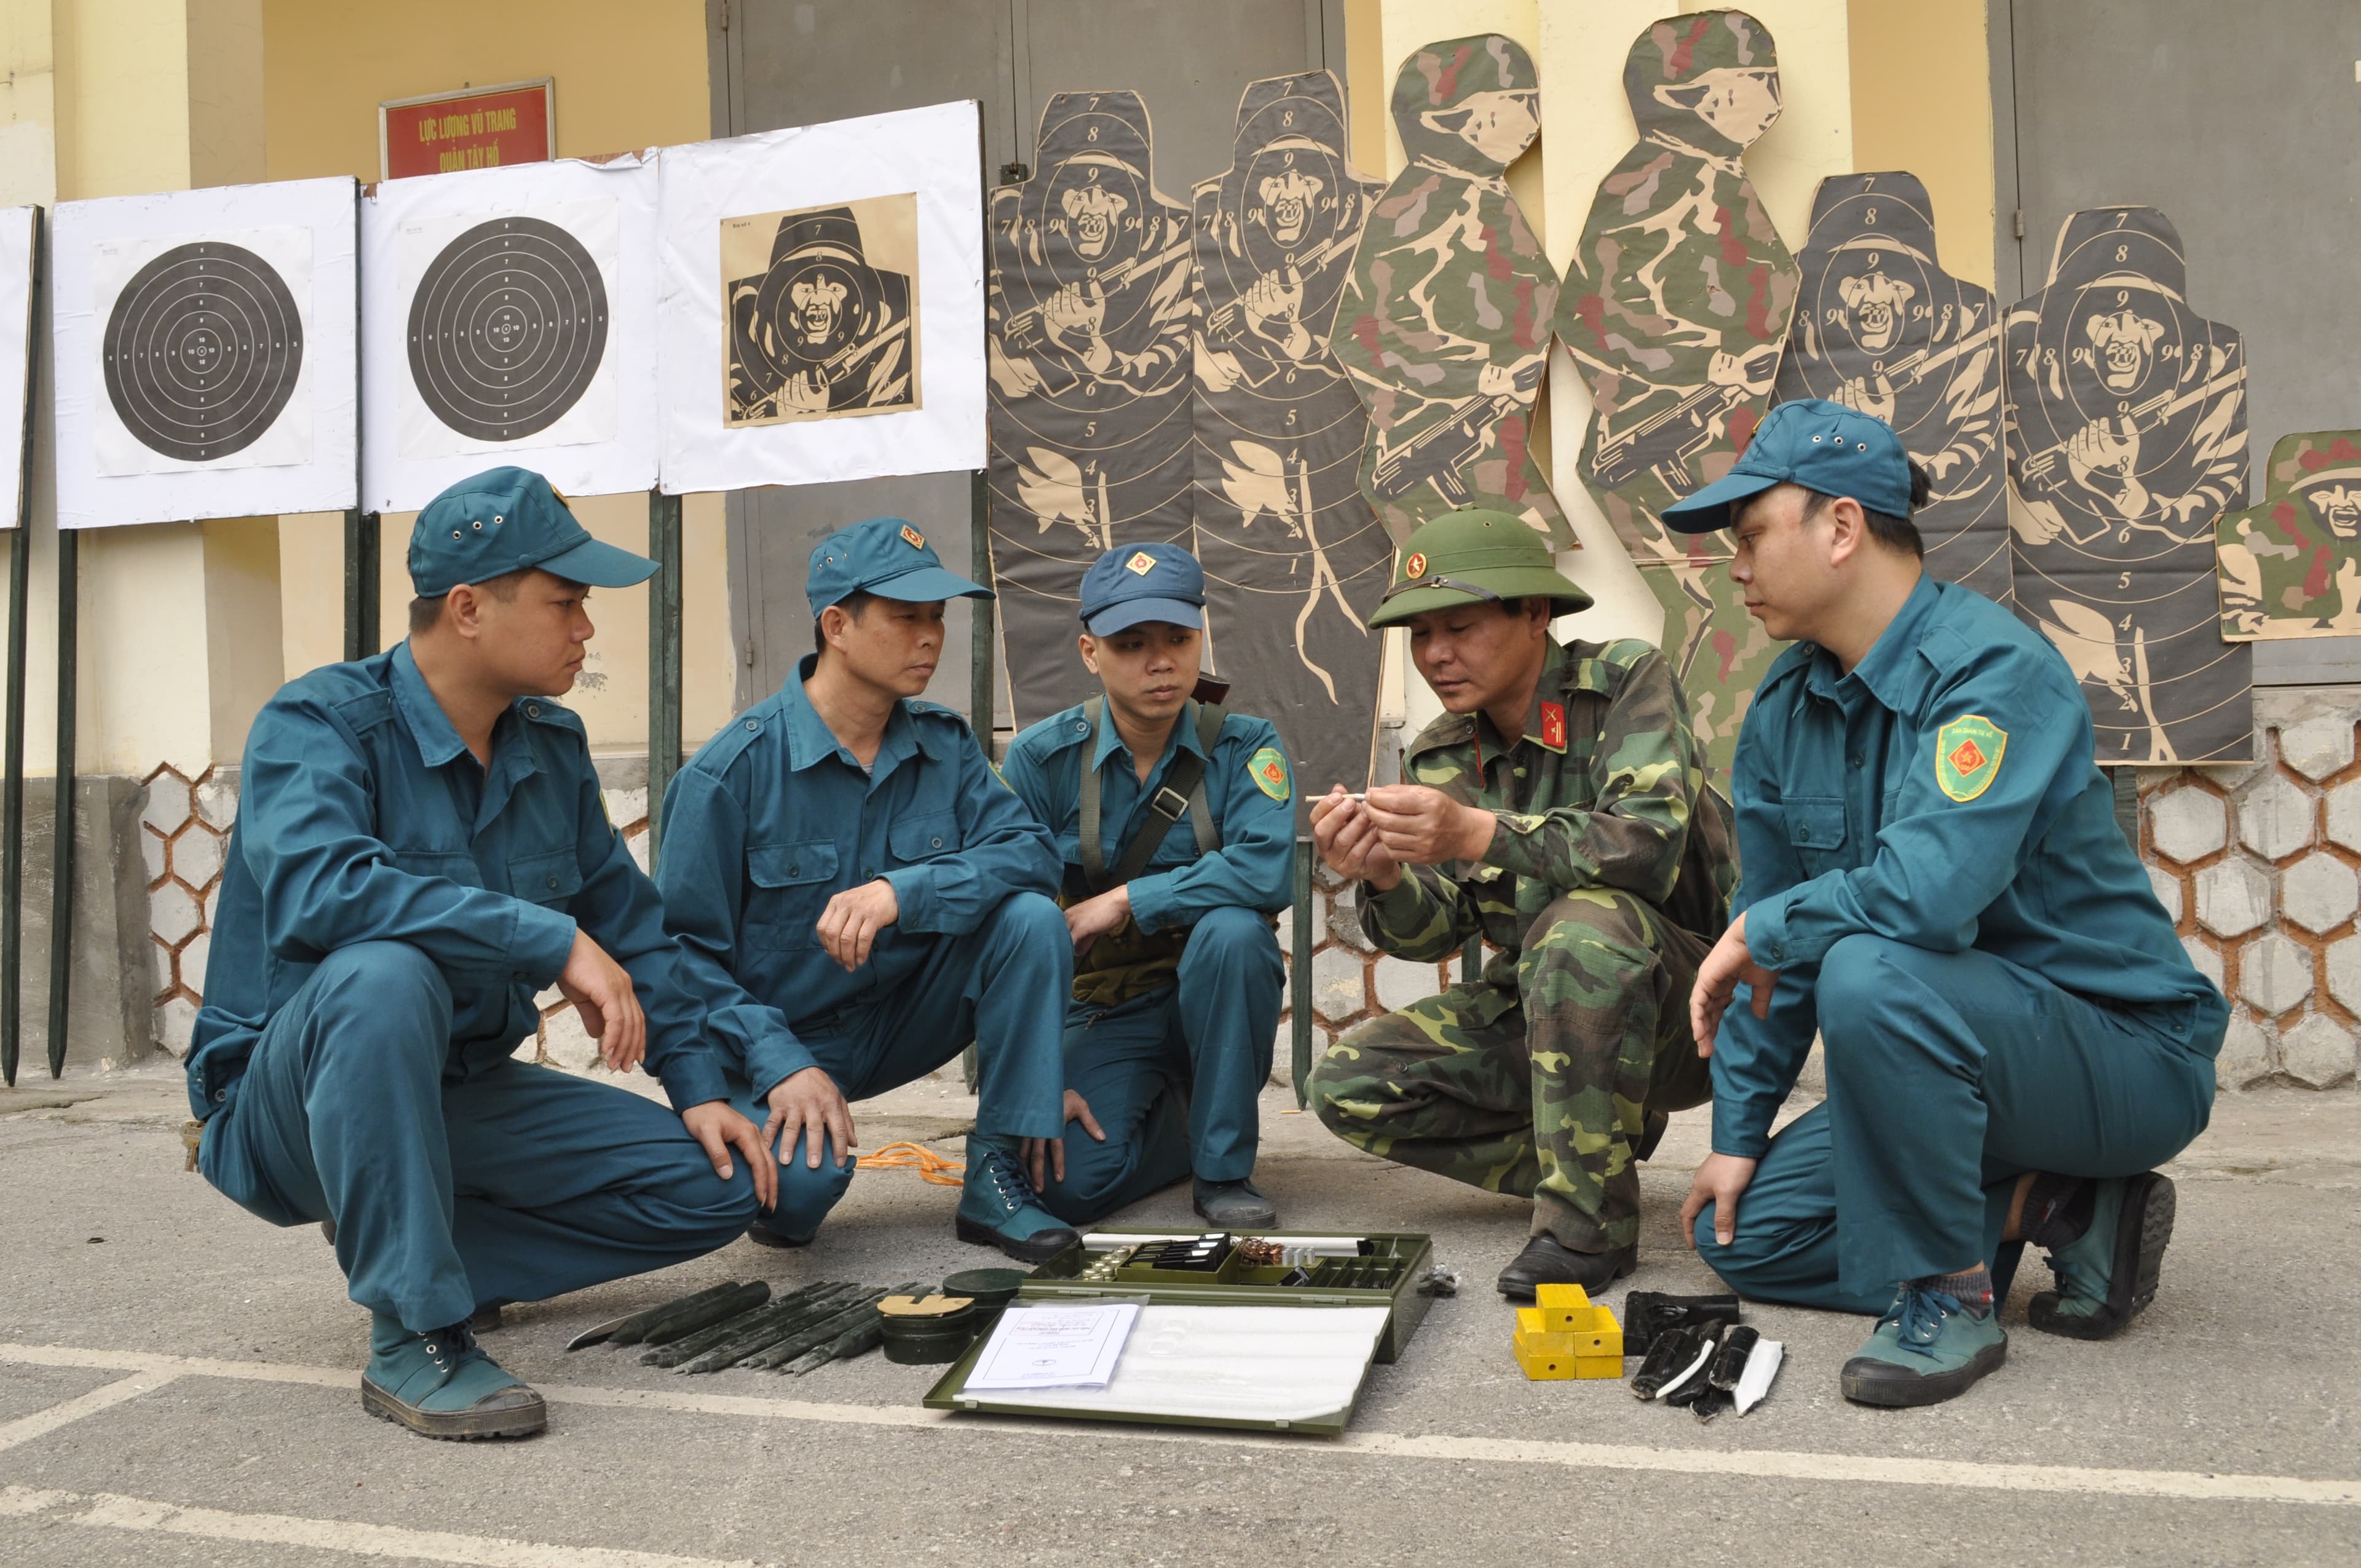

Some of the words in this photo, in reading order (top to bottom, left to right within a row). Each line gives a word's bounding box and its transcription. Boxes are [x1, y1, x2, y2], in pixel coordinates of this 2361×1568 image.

[1284, 81, 1293, 97] 7
[1089, 97, 1099, 111] 7
[419, 117, 437, 146] LỰC
[439, 114, 469, 143] LƯỢNG
[471, 109, 484, 135] VŨ
[486, 108, 516, 133] TRANG
[1283, 111, 1293, 127] 8
[1088, 127, 1099, 141] 8
[467, 144, 484, 169] TÂY
[1283, 152, 1294, 168] 9
[1087, 167, 1098, 183] 9
[1864, 177, 1877, 192] 7
[1201, 215, 1211, 231] 7
[1224, 212, 1235, 228] 8
[1248, 208, 1259, 224] 9
[1282, 204, 1300, 220] 10
[1320, 197, 1331, 213] 9
[1345, 194, 1355, 208] 8
[1865, 208, 1877, 225] 8
[1001, 220, 1011, 235] 7
[1024, 219, 1035, 235] 8
[1048, 220, 1060, 234] 9
[1083, 218, 1104, 233] 10
[1124, 217, 1136, 233] 9
[1150, 216, 1161, 231] 8
[1178, 216, 1188, 231] 7
[2115, 213, 2129, 229] 7
[815, 224, 821, 235] 7
[816, 251, 823, 261] 8
[1284, 252, 1295, 269] 9
[1867, 252, 1880, 269] 9
[2115, 244, 2129, 263] 8
[817, 274, 824, 283] 9
[1086, 267, 1097, 283] 9
[2116, 290, 2129, 307] 9
[1285, 303, 1295, 319] 8
[1798, 309, 1810, 327] 8
[1825, 309, 1838, 325] 9
[1866, 307, 1888, 324] 10
[1912, 306, 1925, 322] 9
[1940, 303, 1953, 321] 8
[1972, 303, 1985, 319] 7
[1086, 316, 1096, 332] 8
[797, 336, 804, 347] 9
[838, 331, 845, 342] 9
[1287, 332, 1296, 349] 7
[782, 354, 789, 364] 8
[1086, 346, 1097, 362] 7
[2016, 349, 2028, 366] 7
[2043, 347, 2057, 366] 8
[2071, 346, 2084, 365] 9
[2114, 346, 2137, 365] 10
[2160, 344, 2175, 362] 9
[2190, 343, 2204, 362] 8
[2225, 343, 2238, 360] 7
[869, 362, 876, 373] 7
[1286, 367, 1297, 384] 6
[1871, 360, 1884, 378] 9
[765, 373, 772, 383] 7
[750, 390, 757, 400] 6
[899, 391, 905, 402] 5
[1086, 381, 1097, 396] 6
[738, 406, 744, 416] 5
[1286, 409, 1297, 426] 5
[2116, 400, 2130, 420] 9
[1085, 422, 1096, 437] 5
[1286, 448, 1298, 464] 4
[2116, 455, 2129, 473] 8
[1085, 459, 1096, 475] 4
[1287, 488, 1297, 504] 3
[2116, 486, 2131, 505] 7
[1085, 499, 1095, 514] 3
[1287, 521, 1298, 538] 2
[2118, 525, 2132, 544] 6
[1085, 531, 1095, 547] 2
[1288, 558, 1298, 574] 1
[2118, 571, 2132, 589] 5
[2118, 613, 2134, 632] 4
[2119, 657, 2132, 675] 3
[2119, 693, 2134, 711] 2
[2121, 732, 2132, 751] 1
